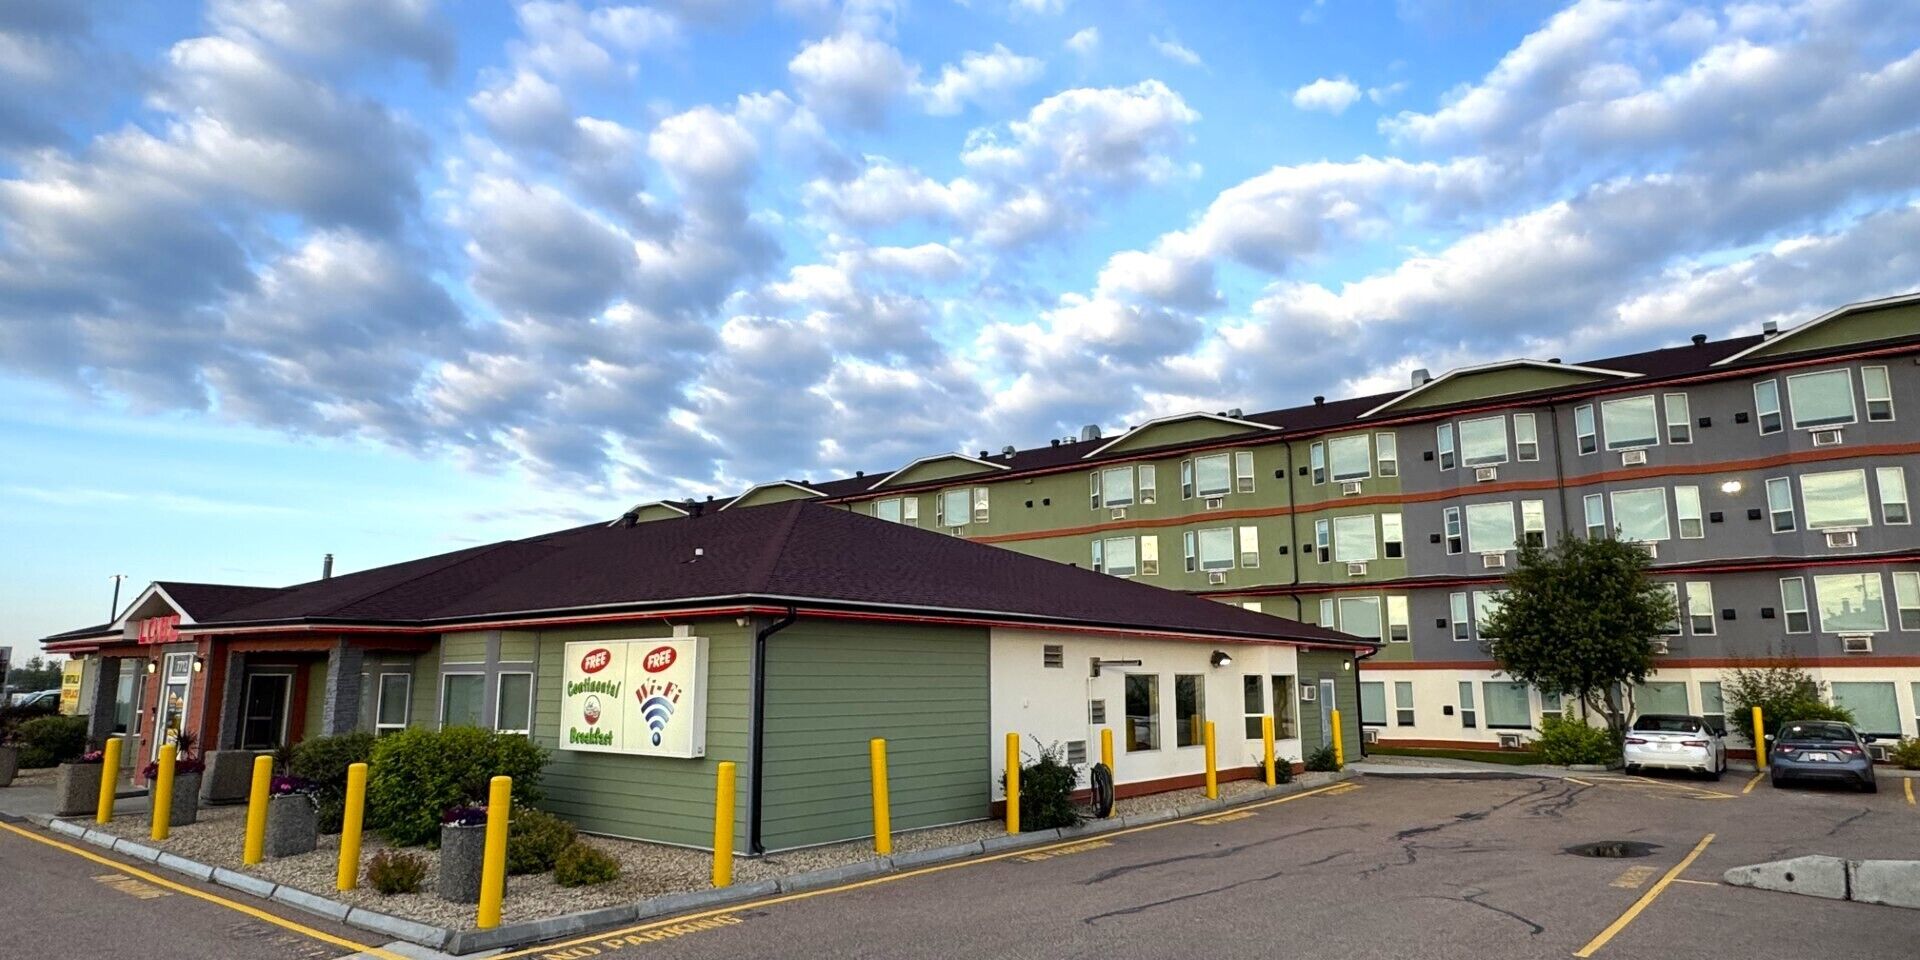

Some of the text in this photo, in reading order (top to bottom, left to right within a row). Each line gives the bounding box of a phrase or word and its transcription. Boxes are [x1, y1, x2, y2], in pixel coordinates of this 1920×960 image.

[585, 651, 607, 670] FREE
[648, 649, 671, 669] FREE
[567, 677, 622, 699] Continental
[635, 677, 682, 704] Wi-Fi
[569, 726, 614, 746] Breakfast
[601, 914, 744, 949] PARKING
